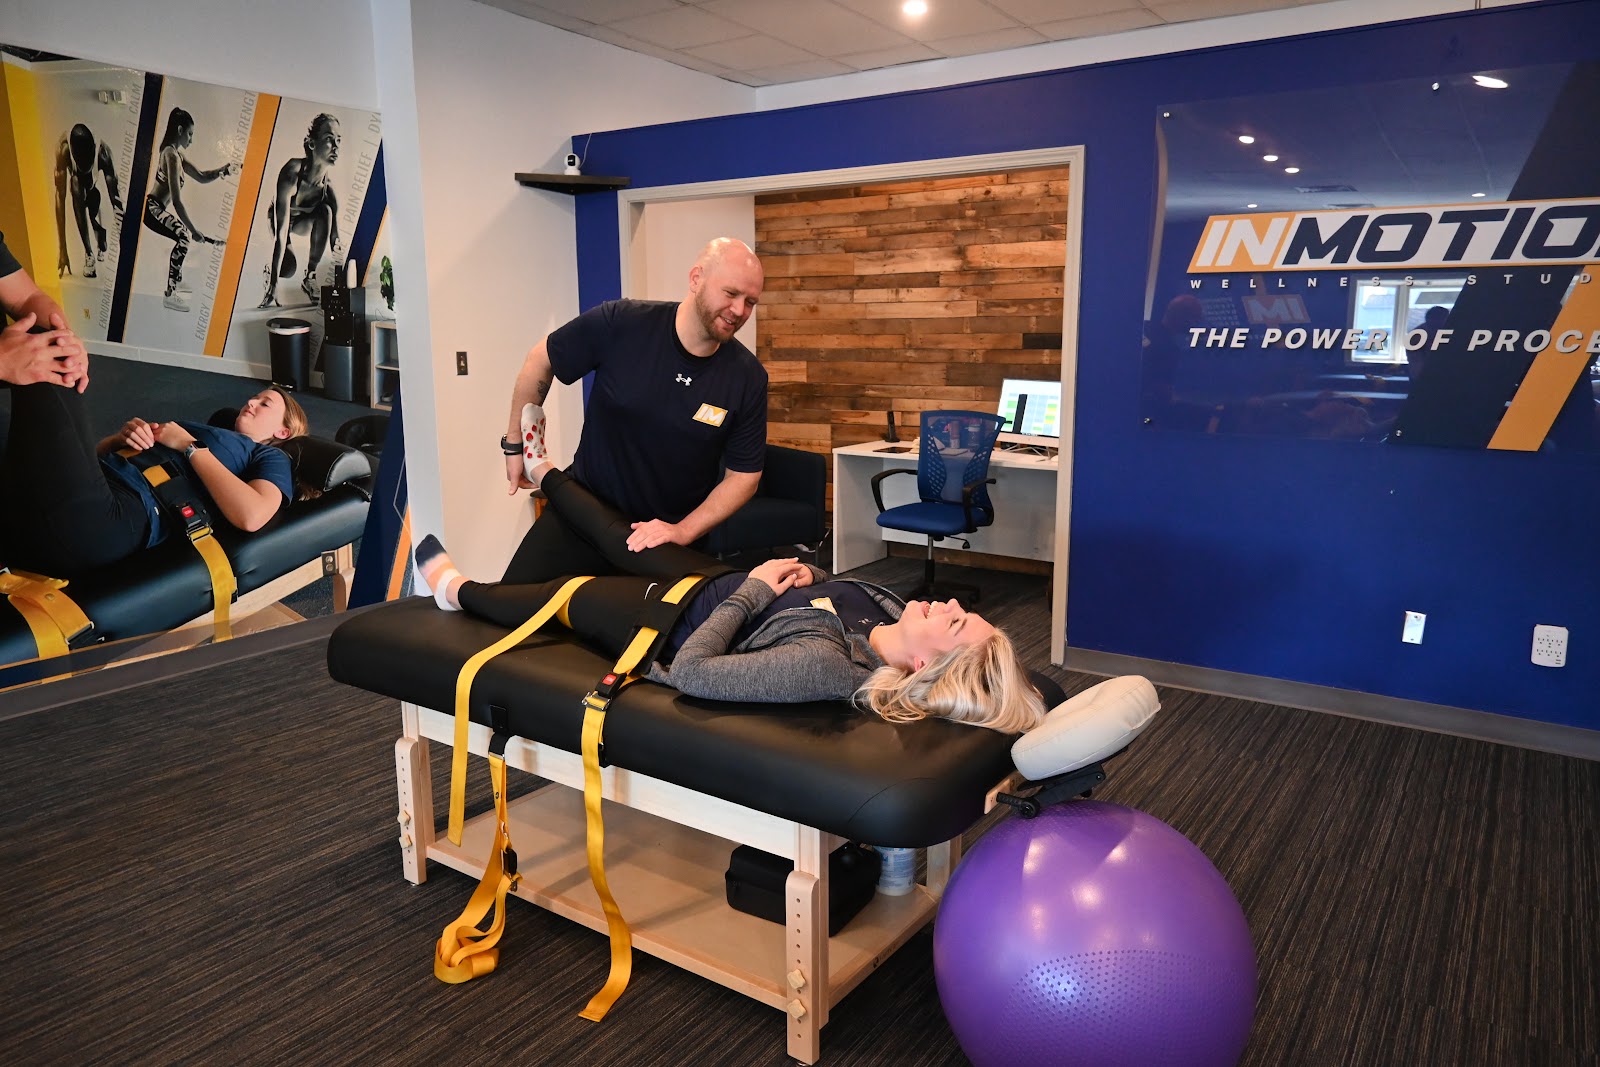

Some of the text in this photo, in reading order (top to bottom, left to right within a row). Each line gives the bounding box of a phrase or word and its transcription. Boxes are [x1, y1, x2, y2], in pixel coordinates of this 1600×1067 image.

[99, 276, 113, 330] ENDURANCE
[119, 131, 135, 193] STRUCTURE
[129, 83, 142, 115] CALM
[343, 194, 361, 223] PAIN
[352, 152, 372, 192] RELIEF
[195, 303, 211, 341] ENERGY
[206, 244, 223, 290] BALANCE
[218, 192, 234, 231] POWER
[1196, 205, 1600, 267] INMOTIO
[1190, 273, 1592, 289] WELLNESS STUD
[1189, 328, 1250, 348] THE
[1261, 328, 1388, 350] POWER
[1404, 329, 1454, 351] OF
